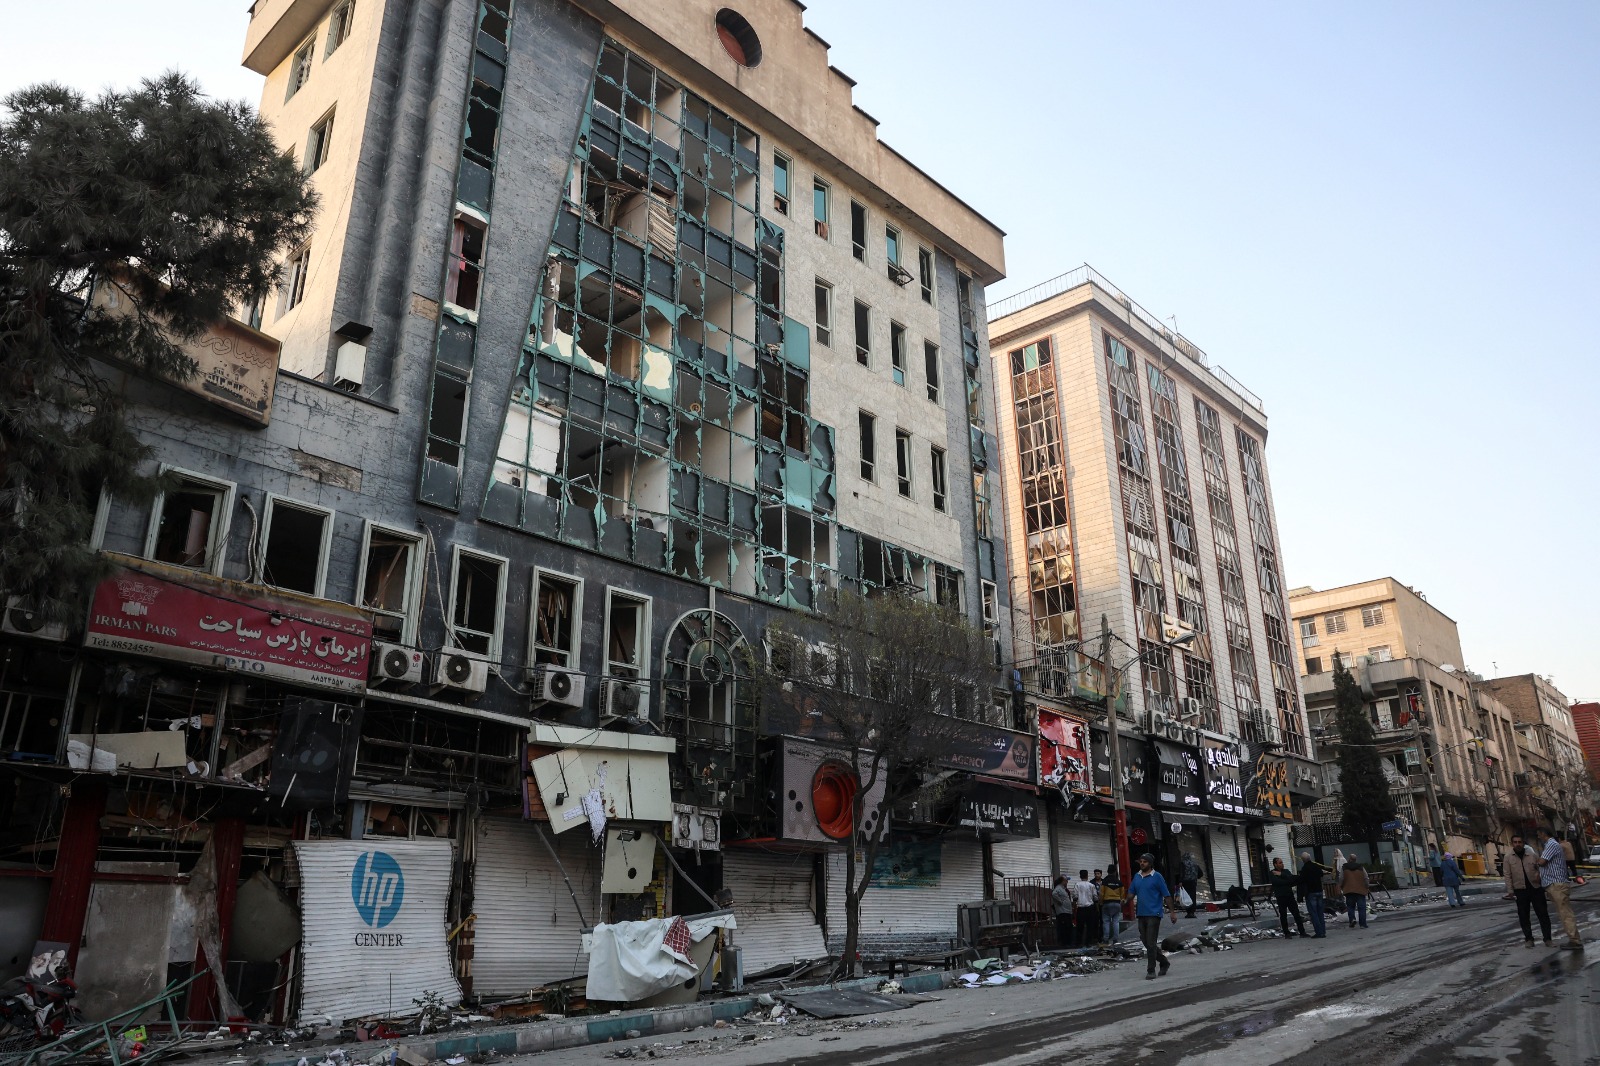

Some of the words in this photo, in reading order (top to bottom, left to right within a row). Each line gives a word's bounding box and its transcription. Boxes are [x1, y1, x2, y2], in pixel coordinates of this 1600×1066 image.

[95, 614, 142, 631] IRMAN
[145, 623, 177, 637] PARS
[199, 615, 262, 642] سیاحت
[92, 637, 109, 648] Tel:
[111, 640, 154, 654] 88524557
[266, 630, 312, 655] پارس
[315, 636, 366, 664] ایرمان
[951, 753, 986, 768] AGENCY
[358, 851, 399, 928] hp
[355, 933, 403, 947] CENTER
